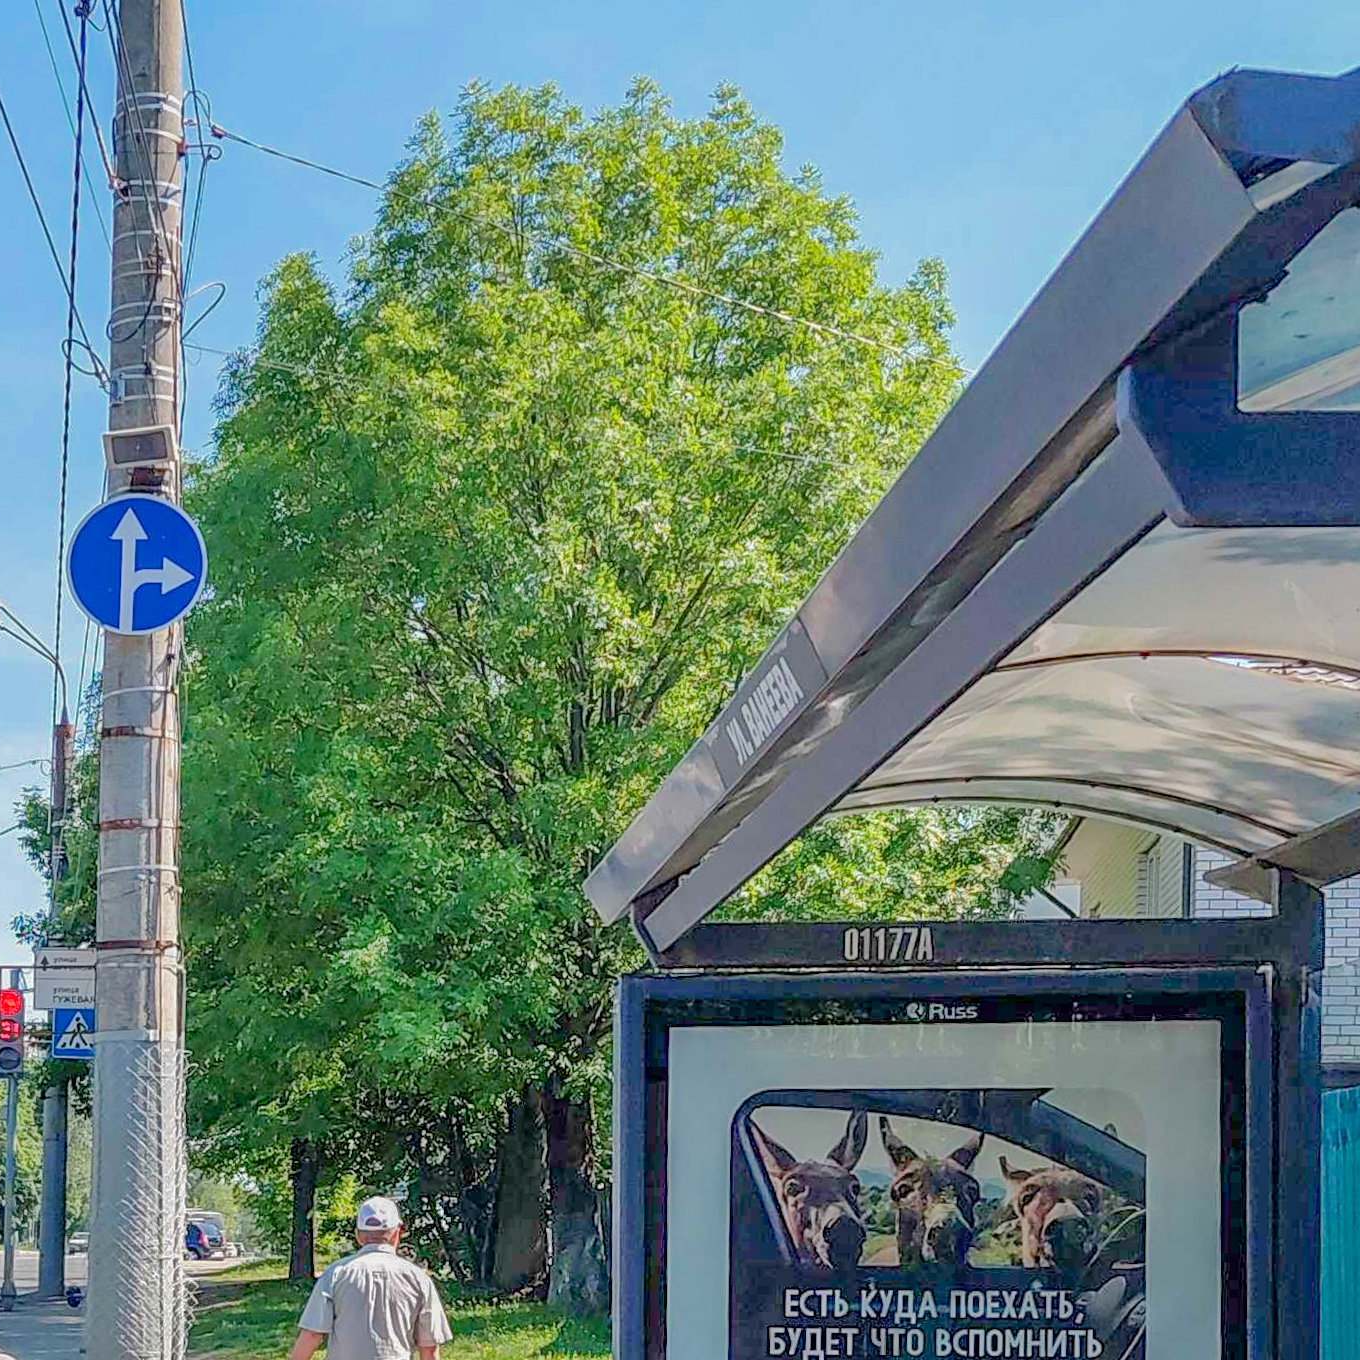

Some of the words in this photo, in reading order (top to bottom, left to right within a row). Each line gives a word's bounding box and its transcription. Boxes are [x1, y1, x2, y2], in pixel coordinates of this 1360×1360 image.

[929, 1003, 979, 1020] Russ
[785, 1288, 849, 1318] ЕСТЬ
[861, 1289, 938, 1324] КУДА
[950, 1290, 1085, 1325] ПОЕХАТЬ,
[870, 1328, 925, 1357] ЧТО
[936, 1328, 1103, 1359] ВСПОМНИТЬ
